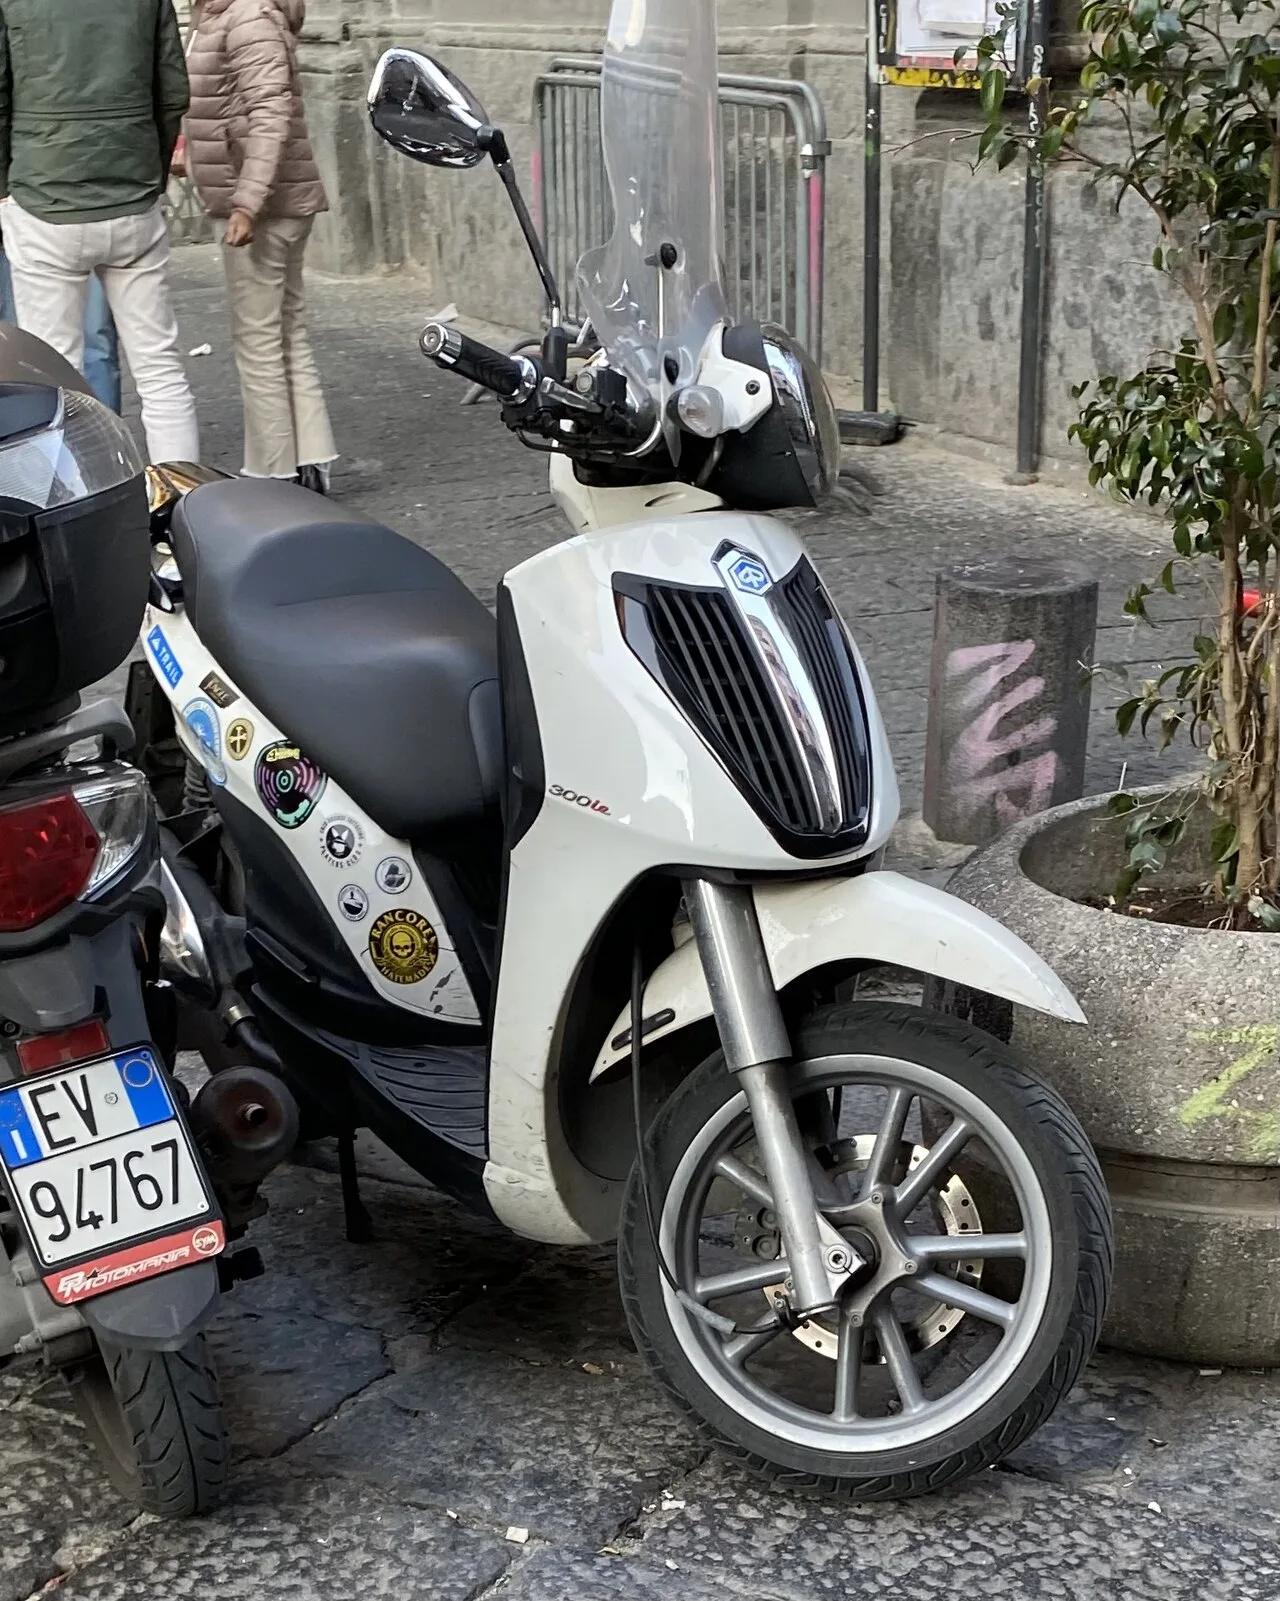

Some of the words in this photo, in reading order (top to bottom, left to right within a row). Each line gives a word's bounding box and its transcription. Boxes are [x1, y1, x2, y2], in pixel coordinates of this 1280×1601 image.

[157, 647, 180, 685] TRAIL
[371, 910, 434, 939] RANCORE
[28, 1074, 98, 1150] EV
[29, 1138, 179, 1243] 94767
